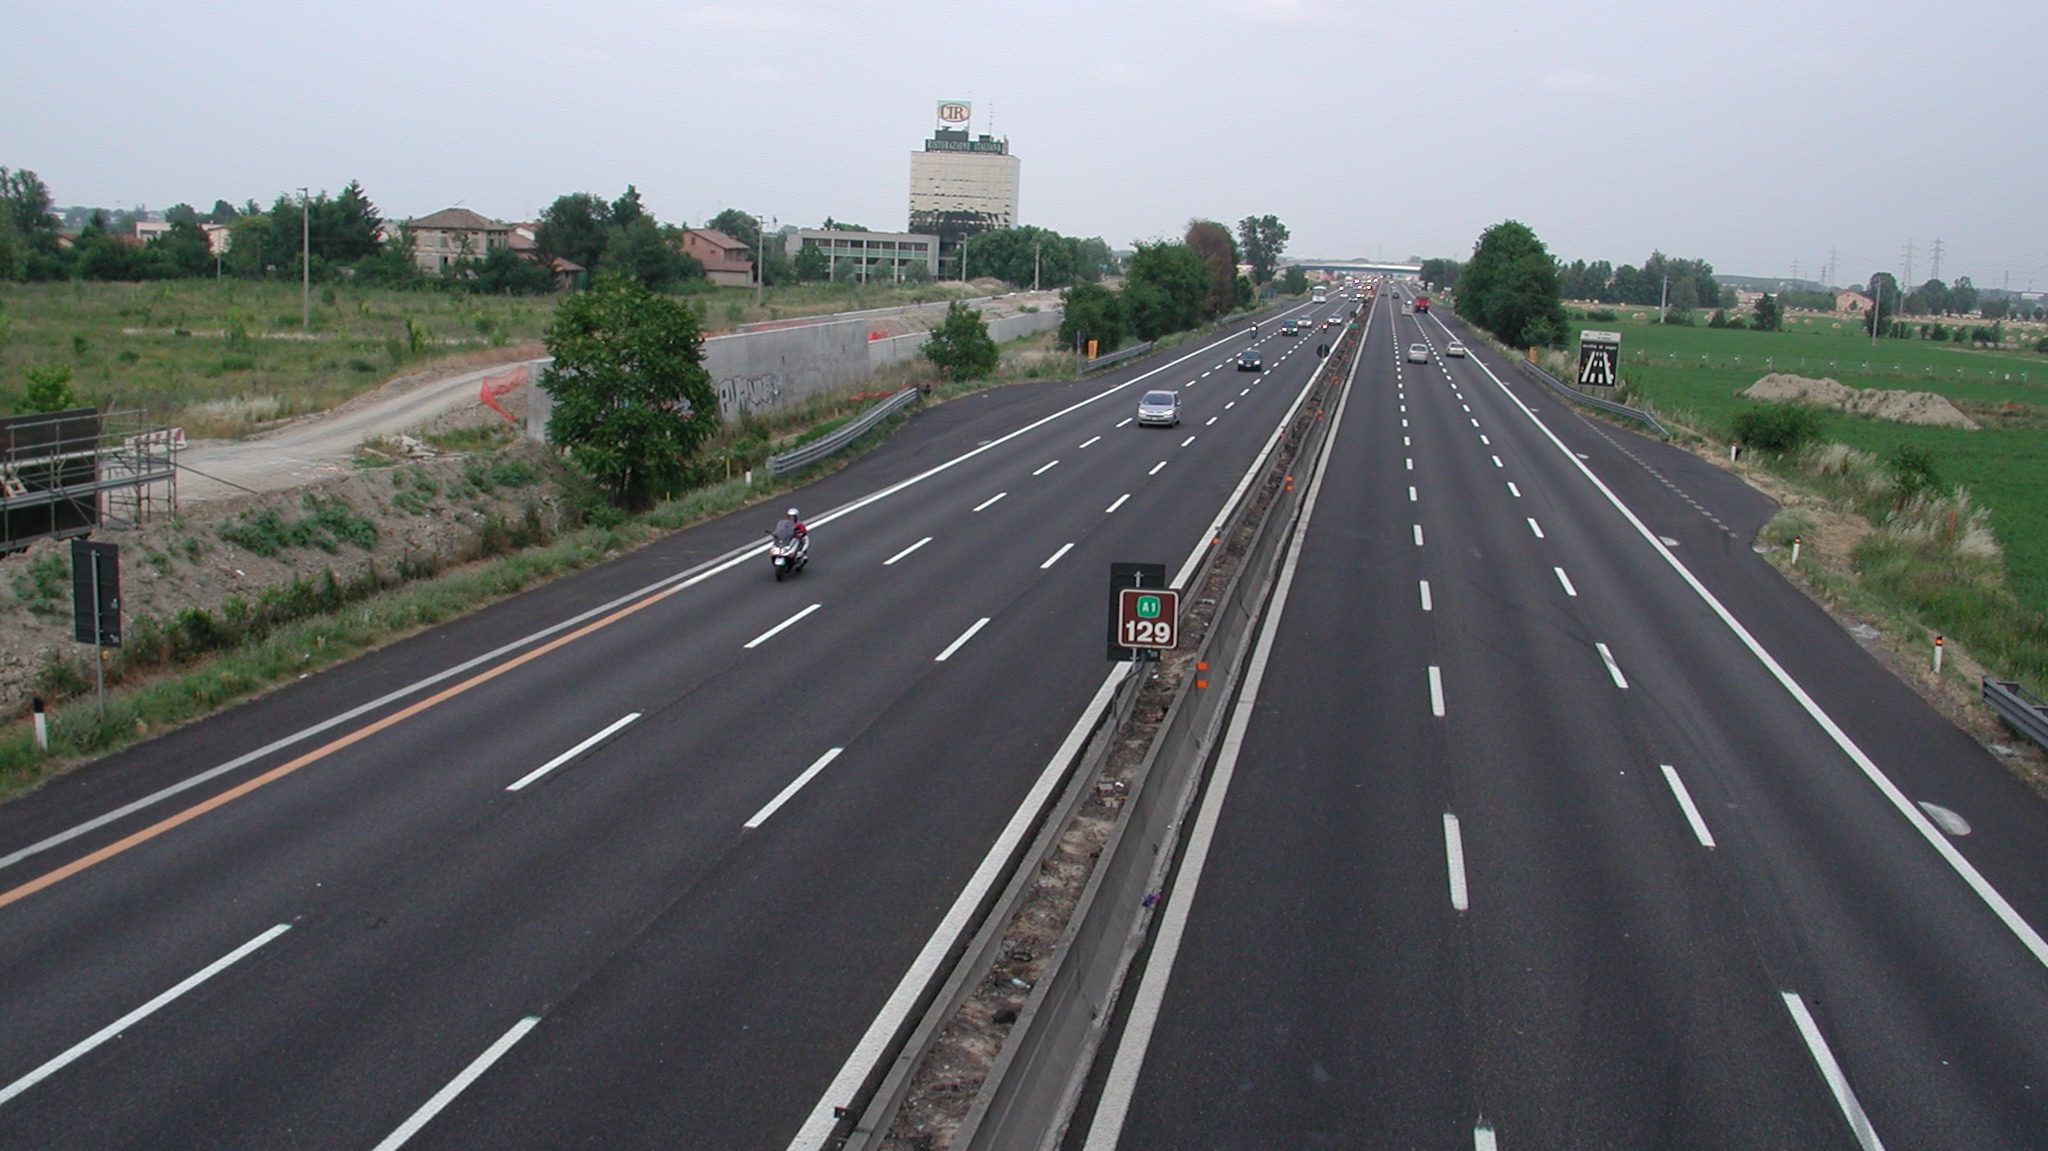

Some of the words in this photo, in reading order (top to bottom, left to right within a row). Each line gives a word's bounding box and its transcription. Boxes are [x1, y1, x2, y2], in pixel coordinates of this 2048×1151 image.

[940, 105, 965, 120] CIR
[1141, 601, 1157, 613] A1
[1125, 620, 1171, 644] 129
